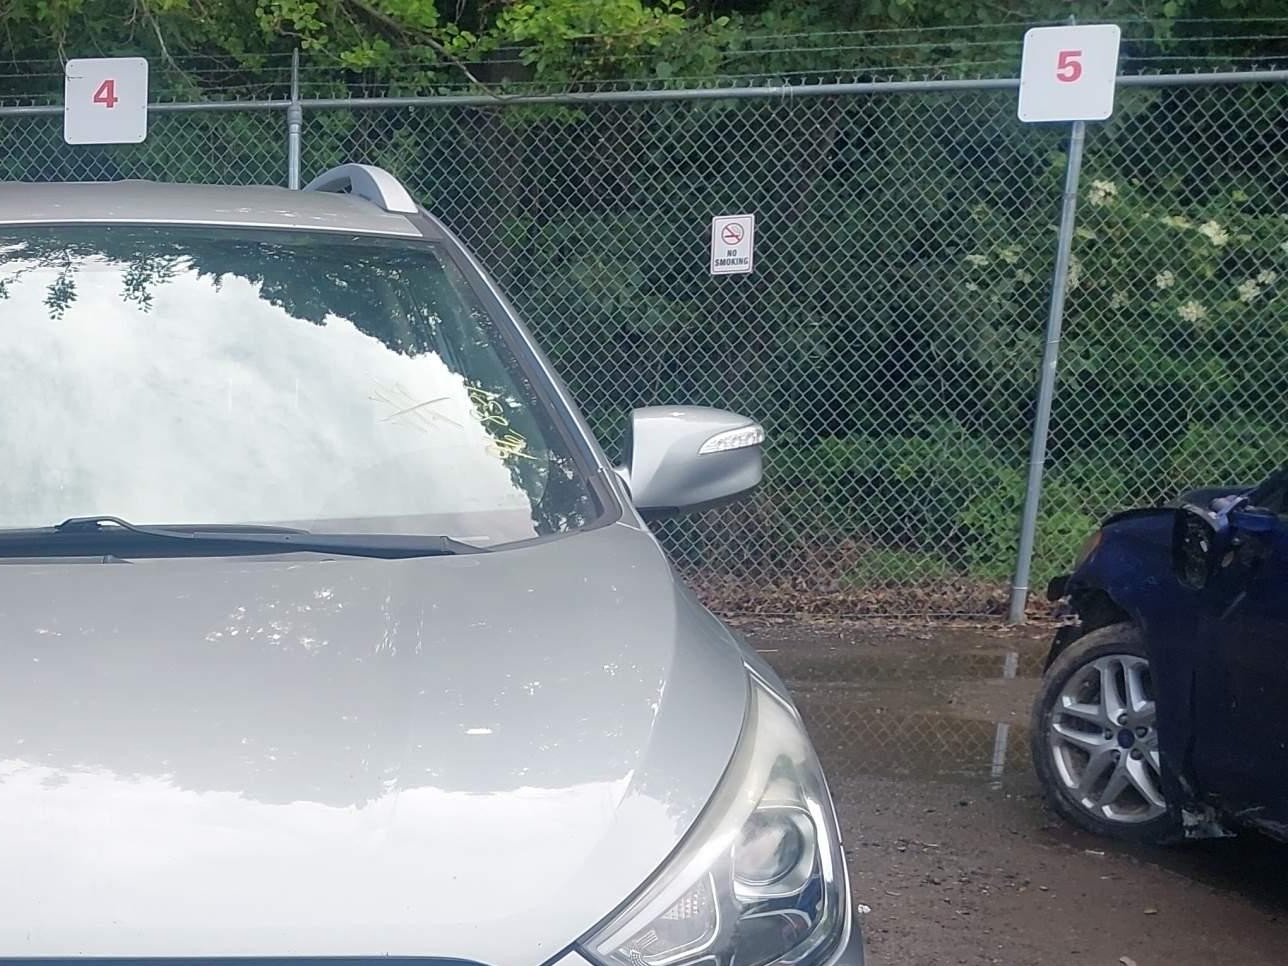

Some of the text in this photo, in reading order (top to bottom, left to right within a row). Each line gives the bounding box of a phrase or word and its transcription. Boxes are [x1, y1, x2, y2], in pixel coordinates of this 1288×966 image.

[1056, 50, 1082, 82] 5
[93, 79, 118, 108] 4
[714, 257, 749, 266] SMOKING
[726, 249, 738, 257] NO
